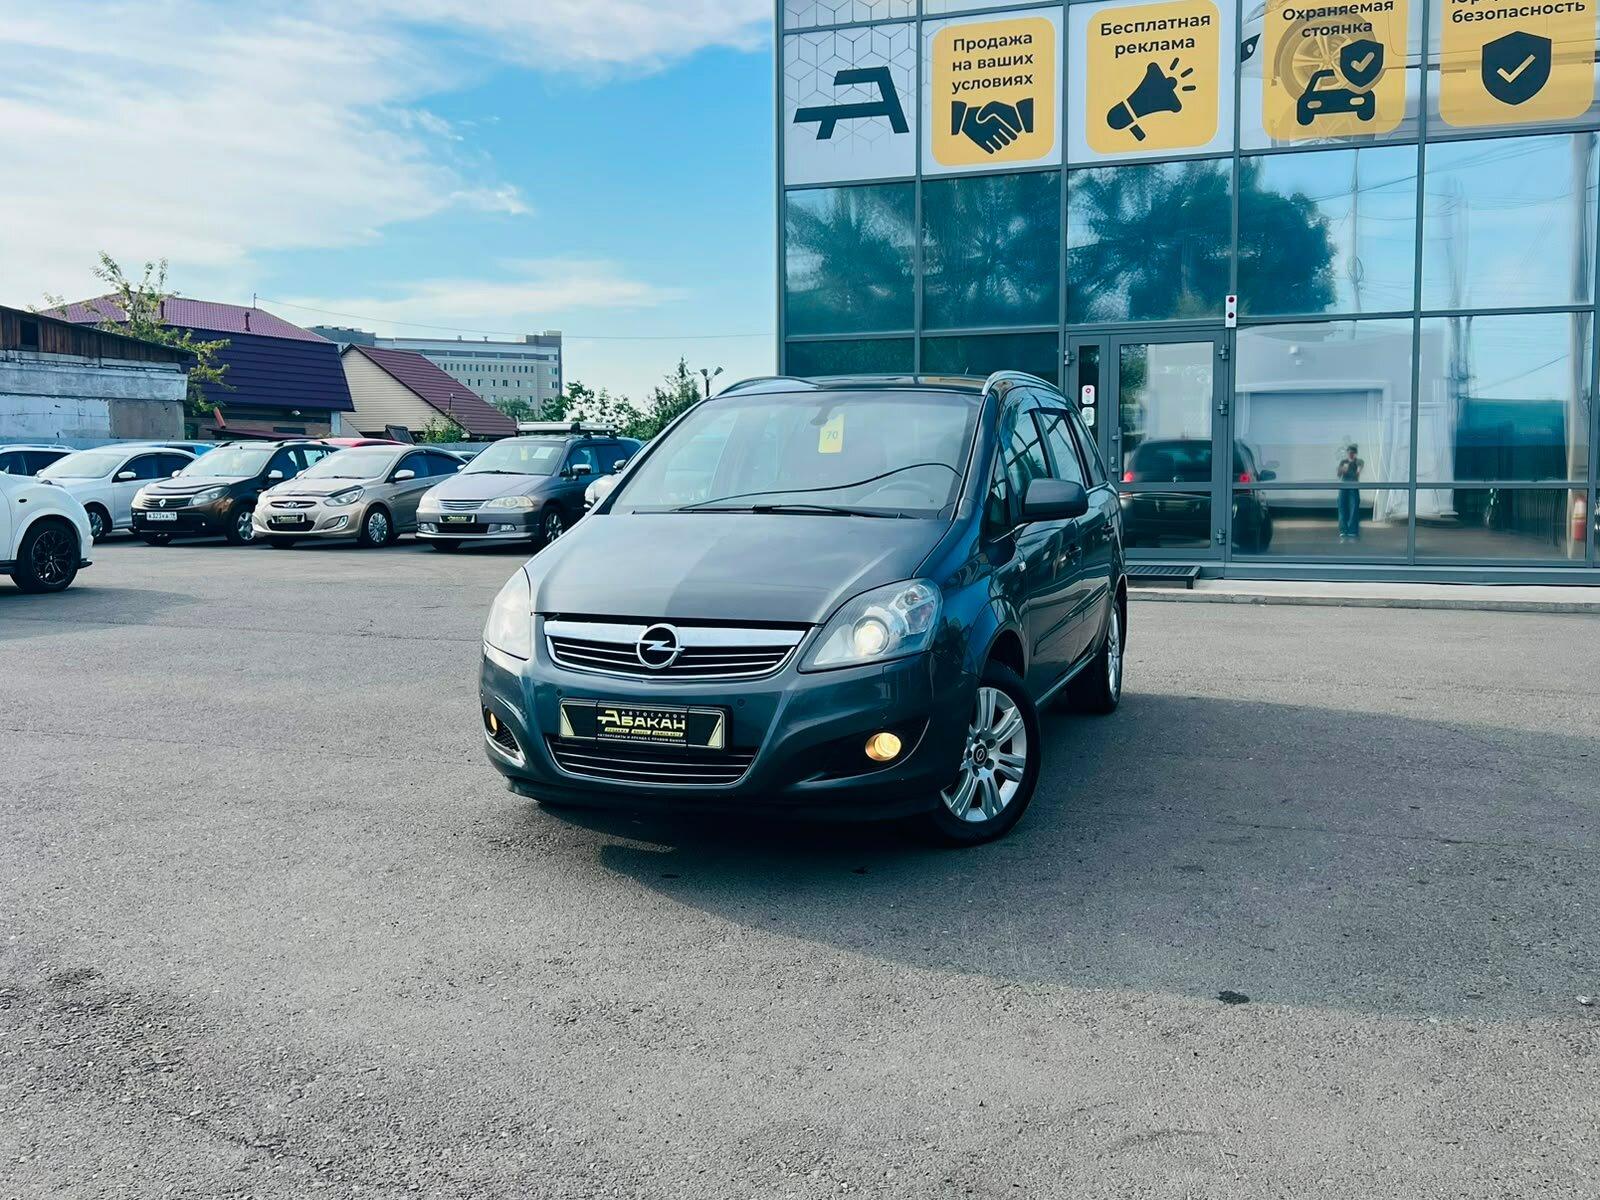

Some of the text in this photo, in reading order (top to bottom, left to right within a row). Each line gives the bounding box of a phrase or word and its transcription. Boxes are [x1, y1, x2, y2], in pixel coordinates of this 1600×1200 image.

[1282, 0, 1394, 22] Охраняемая
[1452, 1, 1586, 23] безопасность
[1100, 15, 1211, 36] Бесплатная
[1301, 22, 1373, 38] стоянка
[953, 33, 1033, 53] Продажа
[1114, 37, 1196, 59] реклама
[952, 53, 1034, 72] на ваших
[951, 74, 1034, 95] условиях
[621, 711, 685, 719] АВТОСАЛОН
